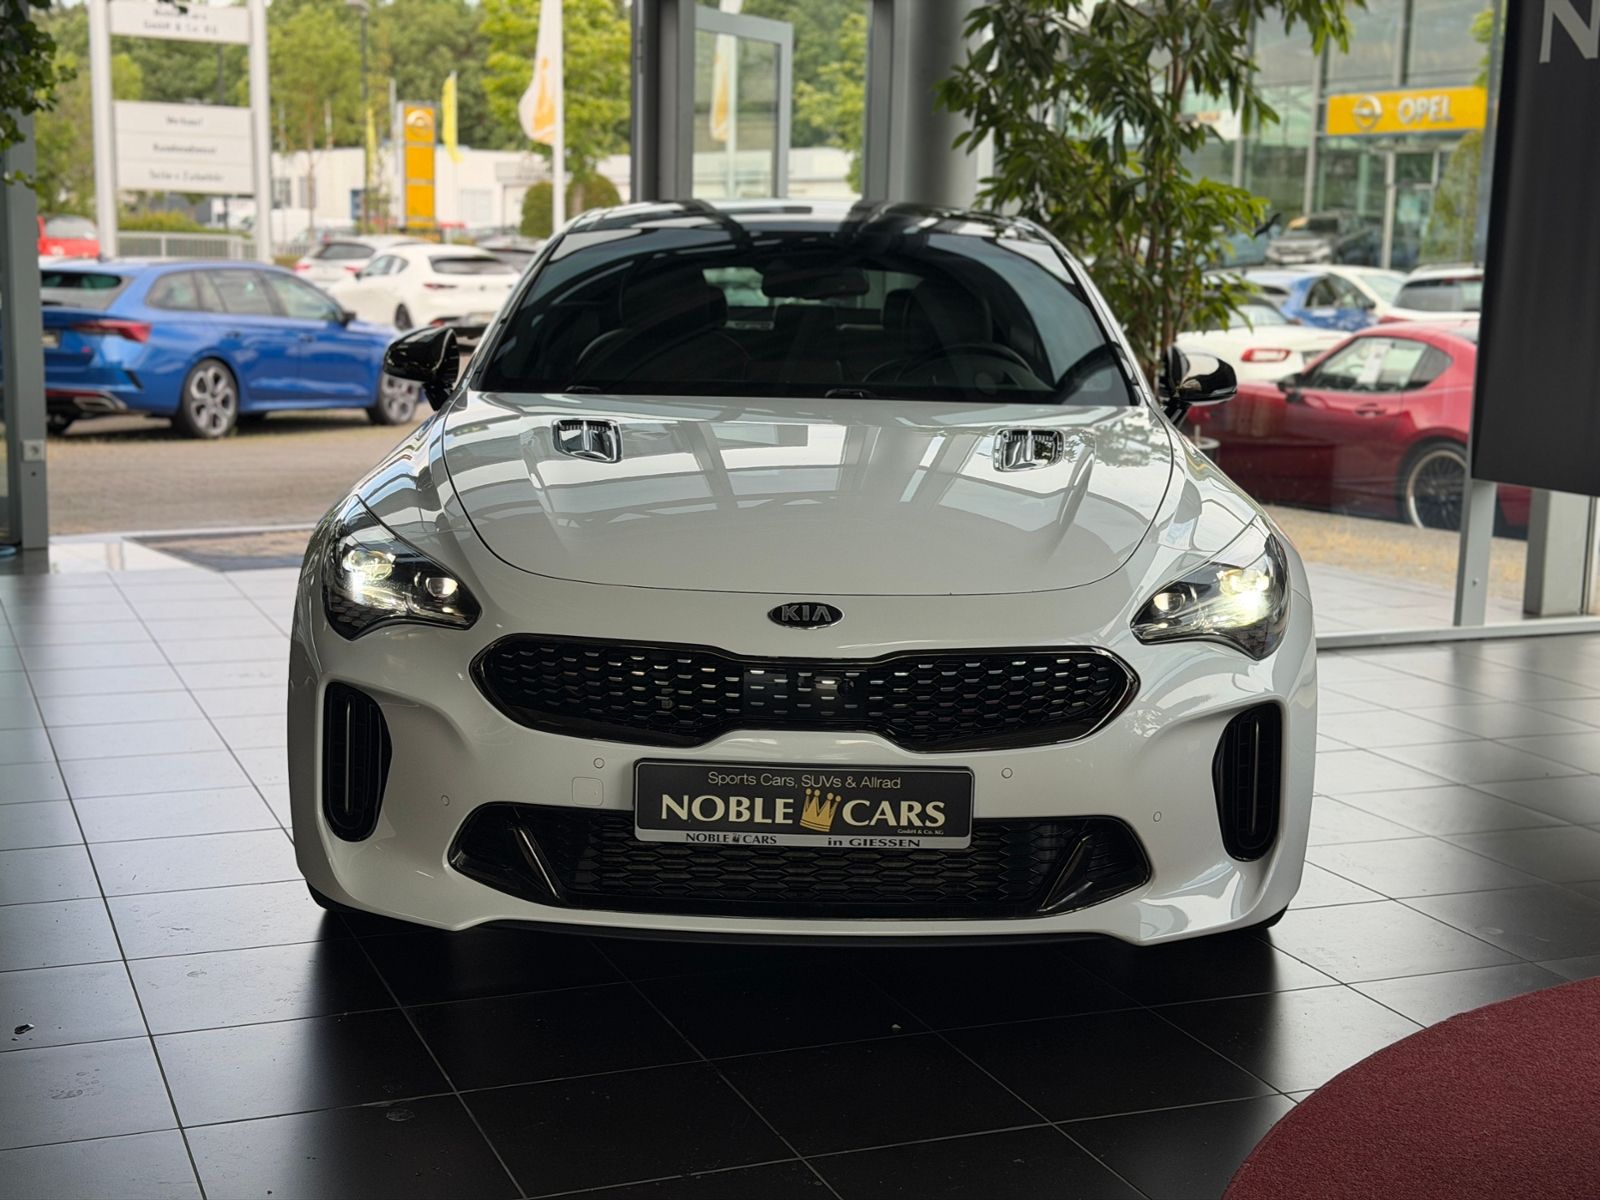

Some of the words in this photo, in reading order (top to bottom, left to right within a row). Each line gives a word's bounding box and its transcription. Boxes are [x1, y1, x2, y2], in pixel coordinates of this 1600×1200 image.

[1398, 95, 1454, 124] OPEL
[781, 604, 832, 622] KIA
[708, 771, 757, 786] Sports
[760, 773, 798, 788] Cars,
[801, 774, 842, 788] SUVs
[845, 776, 857, 788] &
[860, 776, 901, 789] Allrad
[661, 794, 794, 824] NOBLE
[842, 799, 946, 828] CARS
[686, 833, 730, 843] NOBLE
[743, 834, 777, 845] CARS
[827, 837, 842, 846] in
[849, 838, 921, 847] GIESSEN
